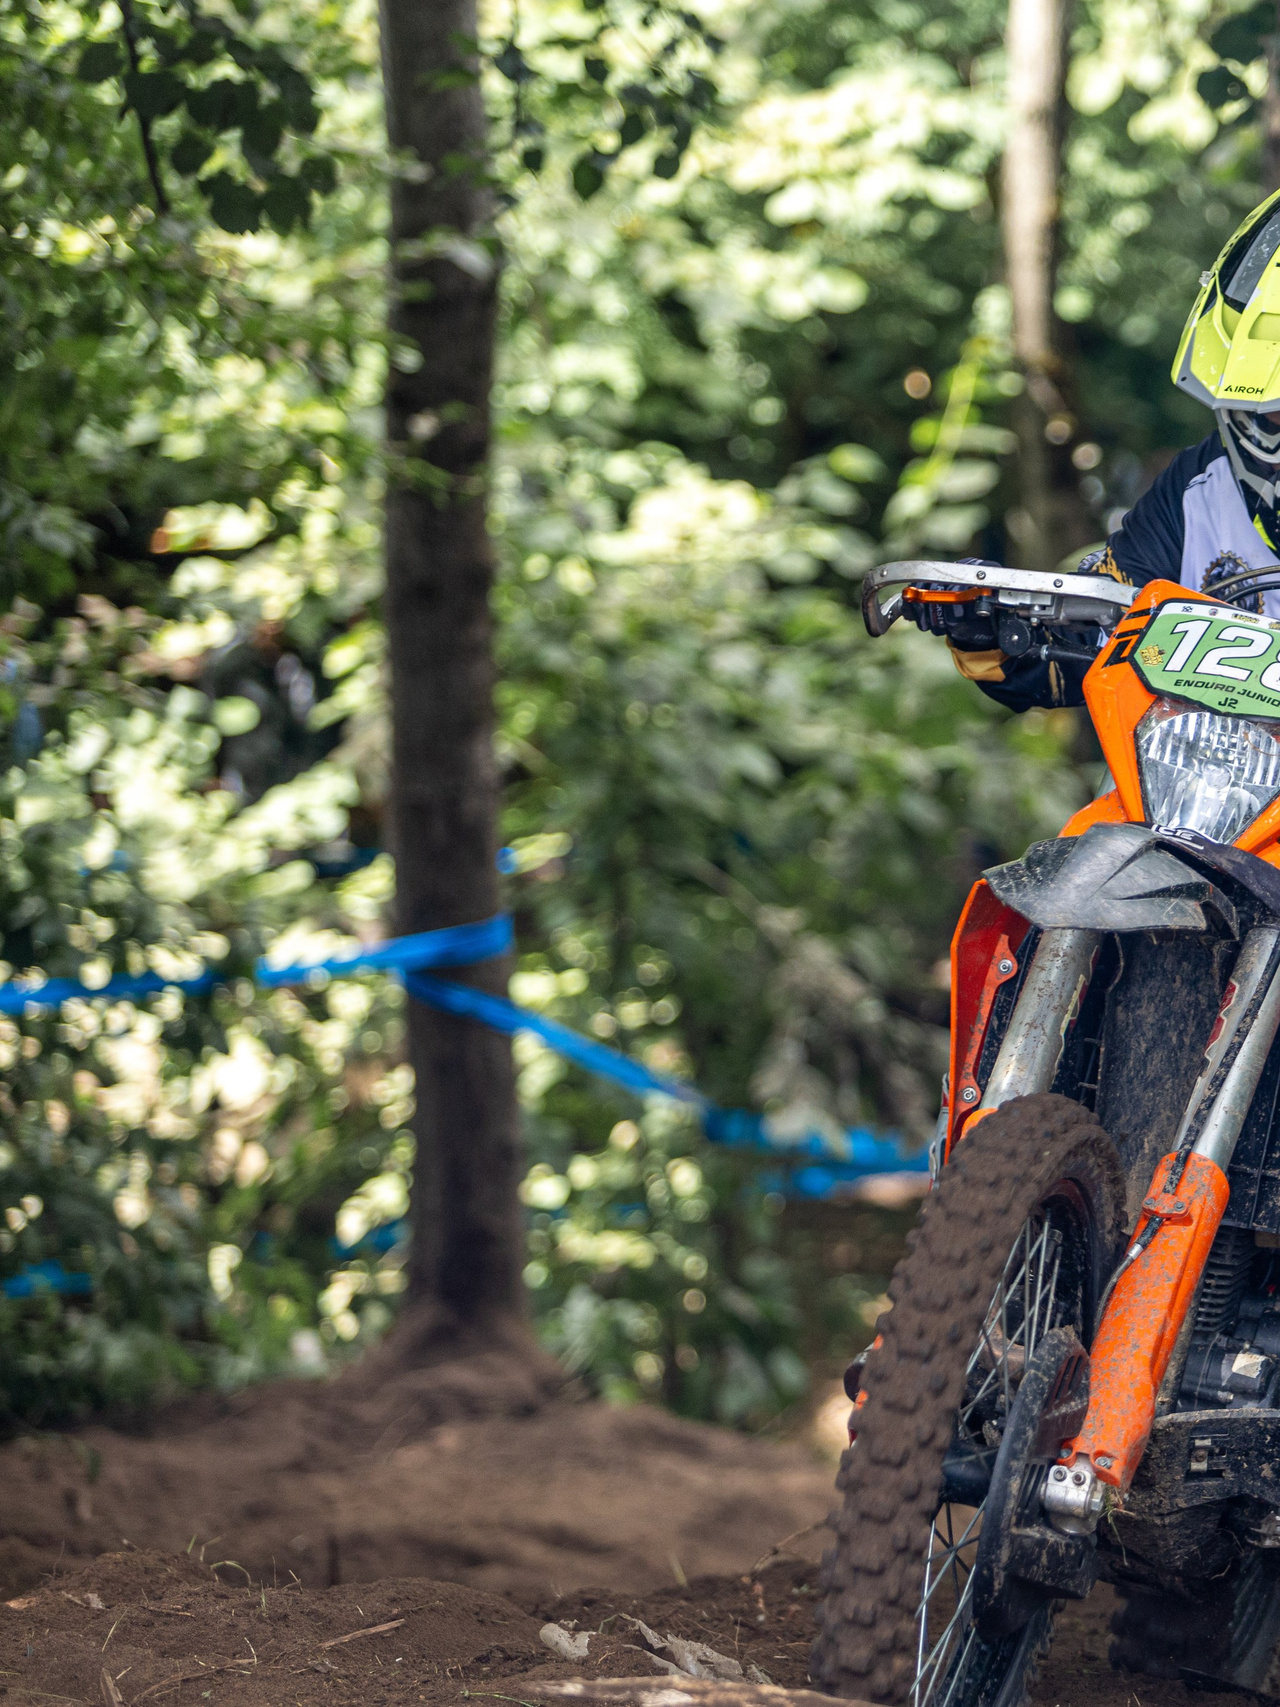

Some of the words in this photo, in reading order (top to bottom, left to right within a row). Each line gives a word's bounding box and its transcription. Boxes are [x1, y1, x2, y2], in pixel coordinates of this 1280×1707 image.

[1224, 384, 1264, 396] AIROH
[1173, 678, 1236, 693] ENDURO
[1217, 697, 1239, 710] J2
